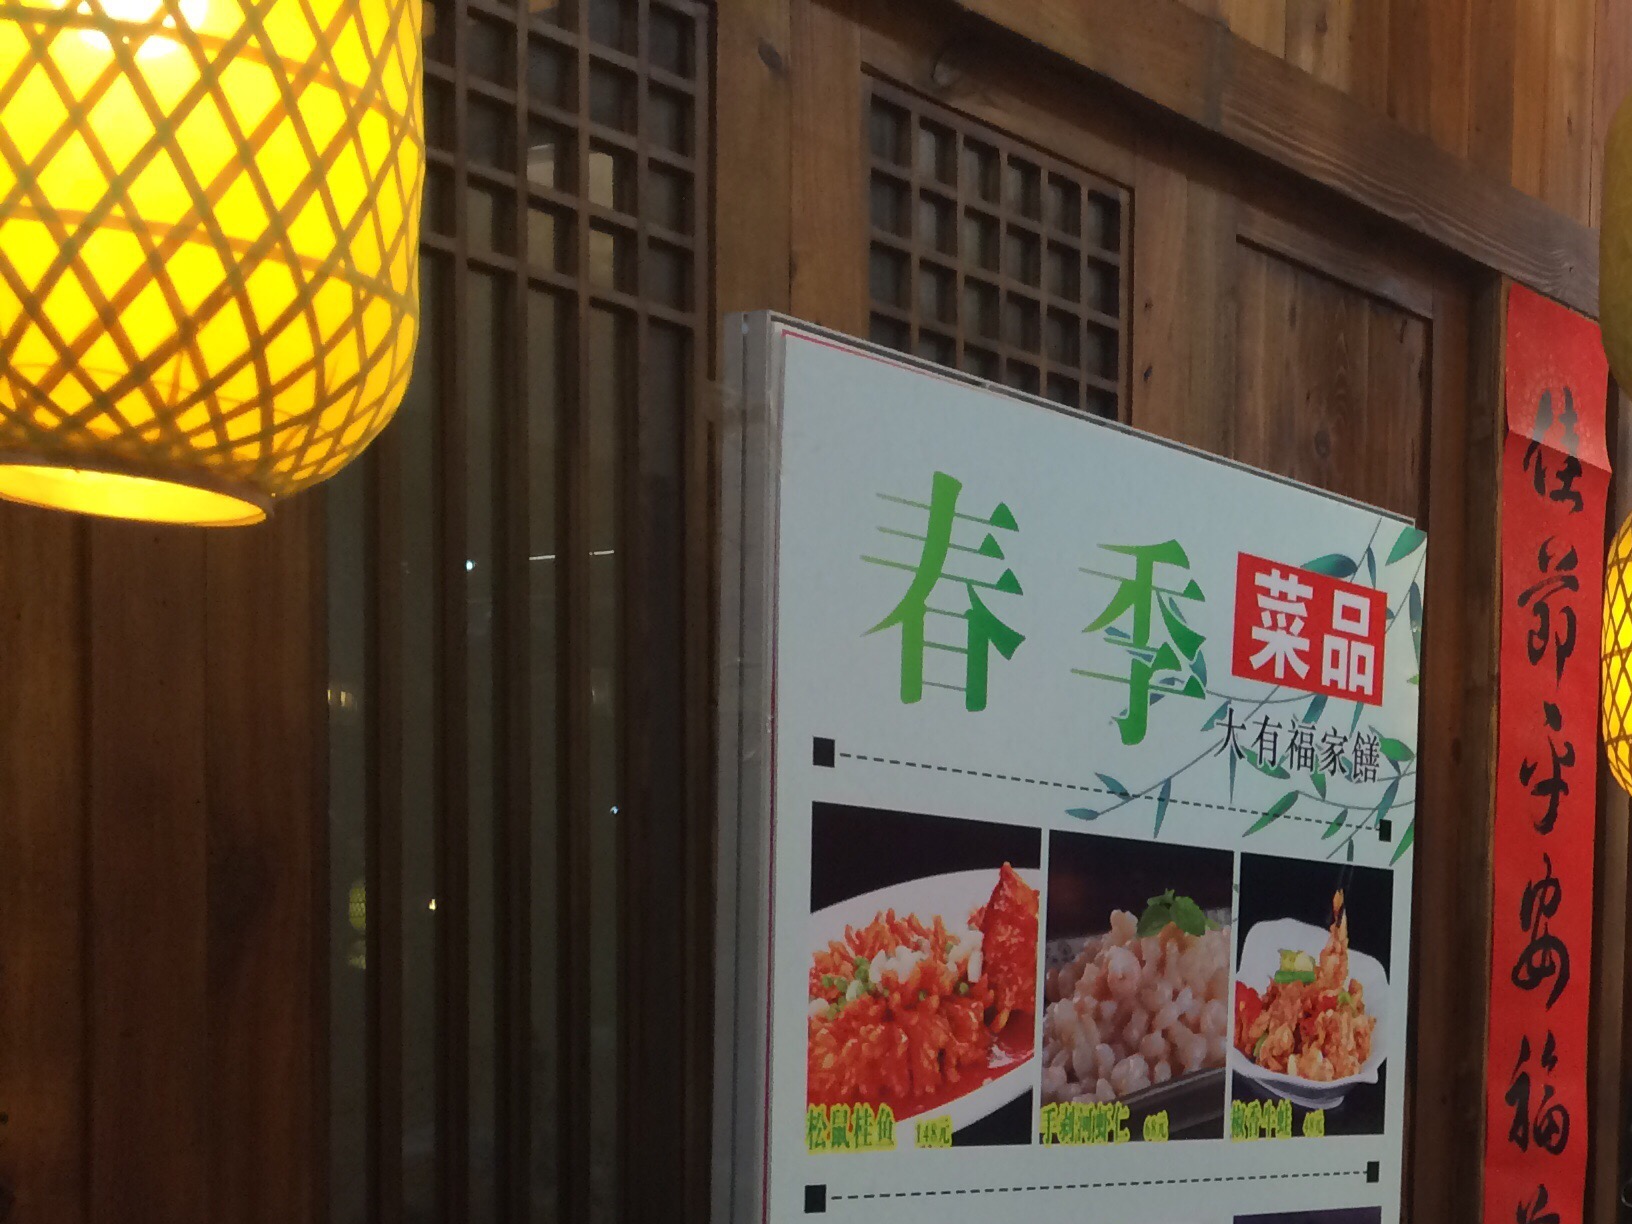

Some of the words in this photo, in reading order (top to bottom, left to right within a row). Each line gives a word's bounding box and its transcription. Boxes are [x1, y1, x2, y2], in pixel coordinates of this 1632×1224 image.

[859, 470, 1207, 746] 春季
[1250, 568, 1377, 698] 菜品
[806, 1104, 895, 1151] 松鼠桂鱼
